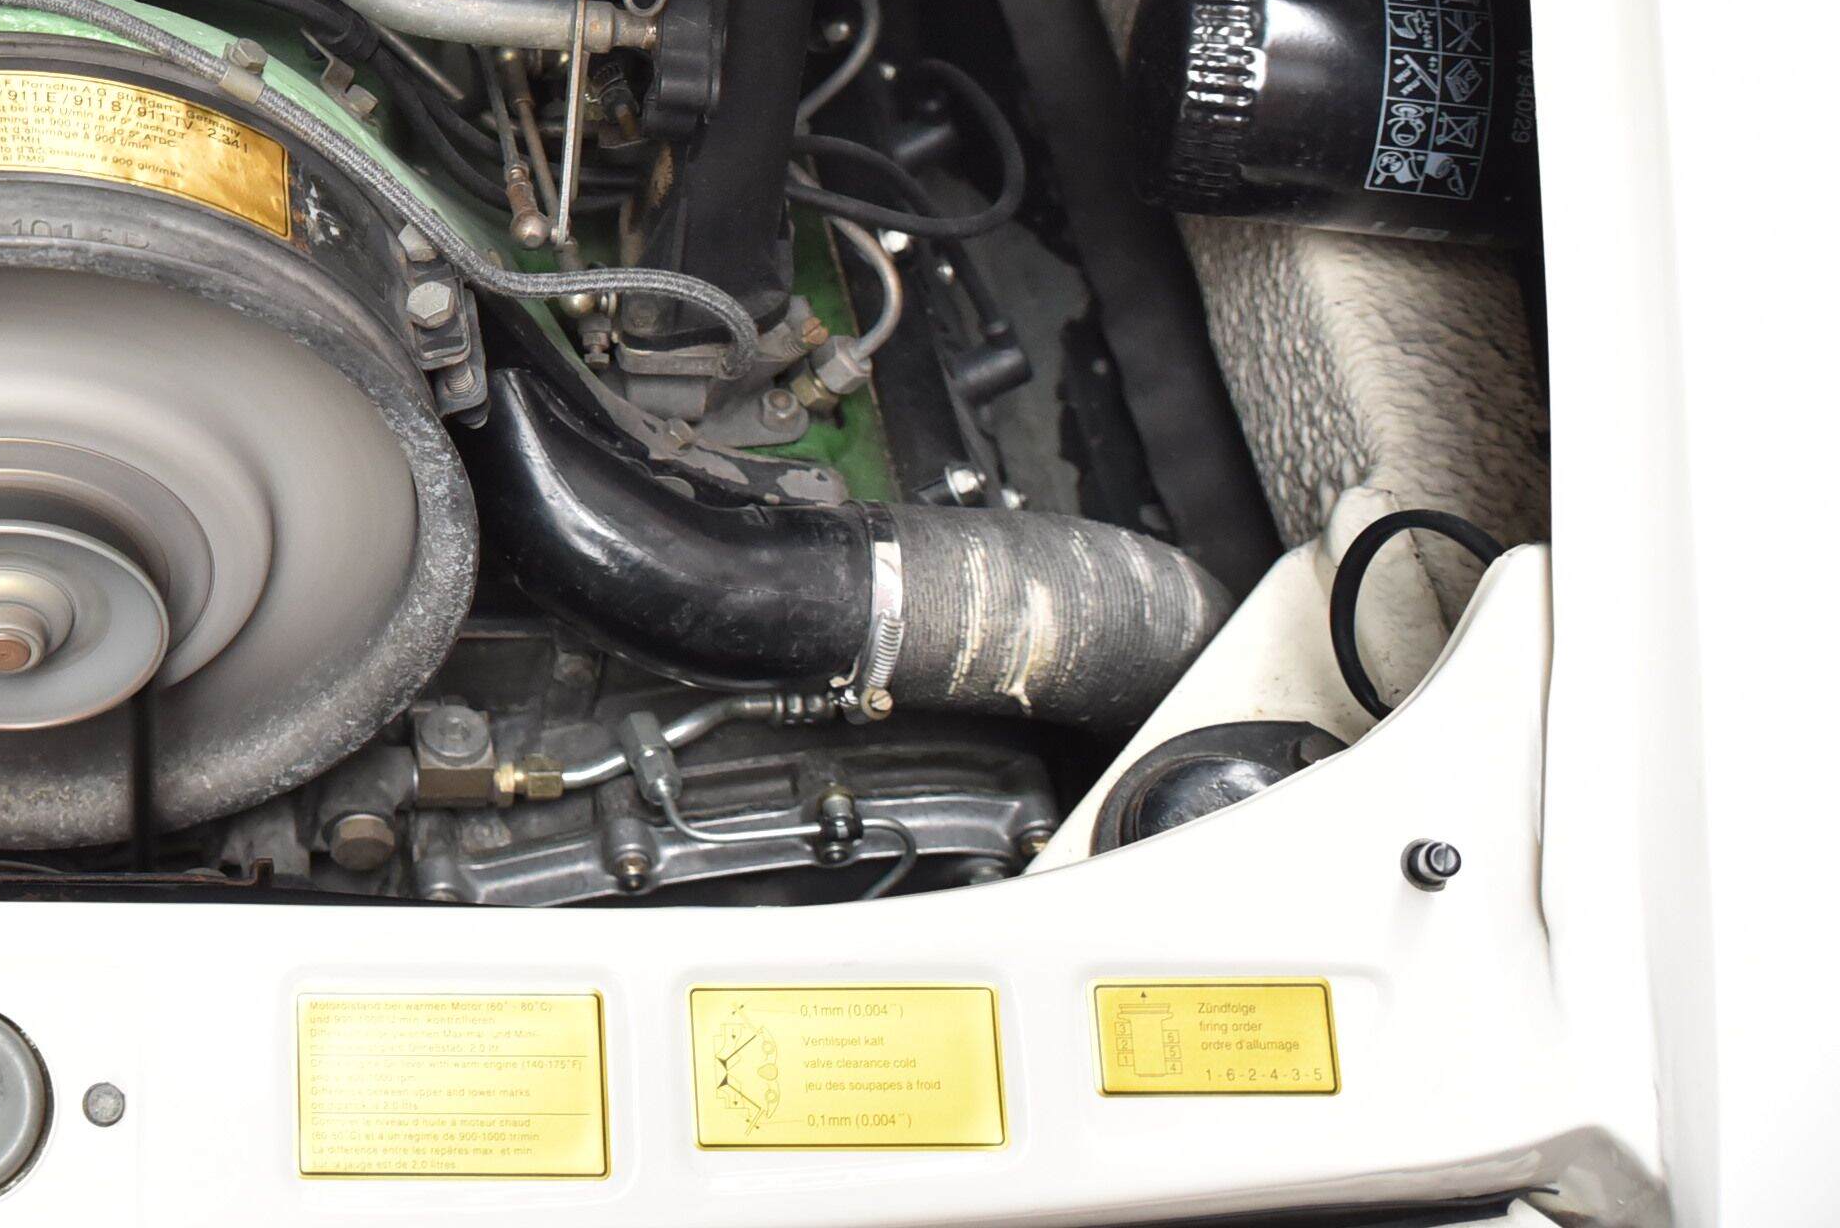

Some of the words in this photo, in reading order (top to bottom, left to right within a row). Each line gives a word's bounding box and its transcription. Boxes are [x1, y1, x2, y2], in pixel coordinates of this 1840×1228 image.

[8, 90, 37, 102] 911
[46, 91, 57, 103] E
[74, 94, 103, 109] 911
[137, 106, 166, 122] 911
[174, 116, 193, 130] TV
[1511, 74, 1534, 144] 940/29
[185, 109, 241, 137] Germany
[144, 134, 177, 148] ATDC
[405, 1002, 447, 1012] warmen
[451, 1001, 482, 1012] Motor
[1197, 1002, 1257, 1015] Zündfolge
[1199, 1021, 1228, 1033] firing
[1231, 1021, 1263, 1032] order
[802, 1035, 861, 1048] Ventilspiel
[864, 1035, 885, 1047] kalt
[1121, 1039, 1129, 1051] 2
[1201, 1039, 1232, 1051] ordre
[1235, 1038, 1300, 1053] d'allumage
[483, 1059, 518, 1072] engine
[804, 1057, 834, 1069] valve
[836, 1057, 891, 1069] clearance
[893, 1057, 917, 1069] cold
[805, 1079, 822, 1093] jeu
[825, 1079, 846, 1091] des
[848, 1081, 904, 1093] soupapes
[916, 1078, 942, 1091] froid
[499, 1117, 531, 1128] chaud
